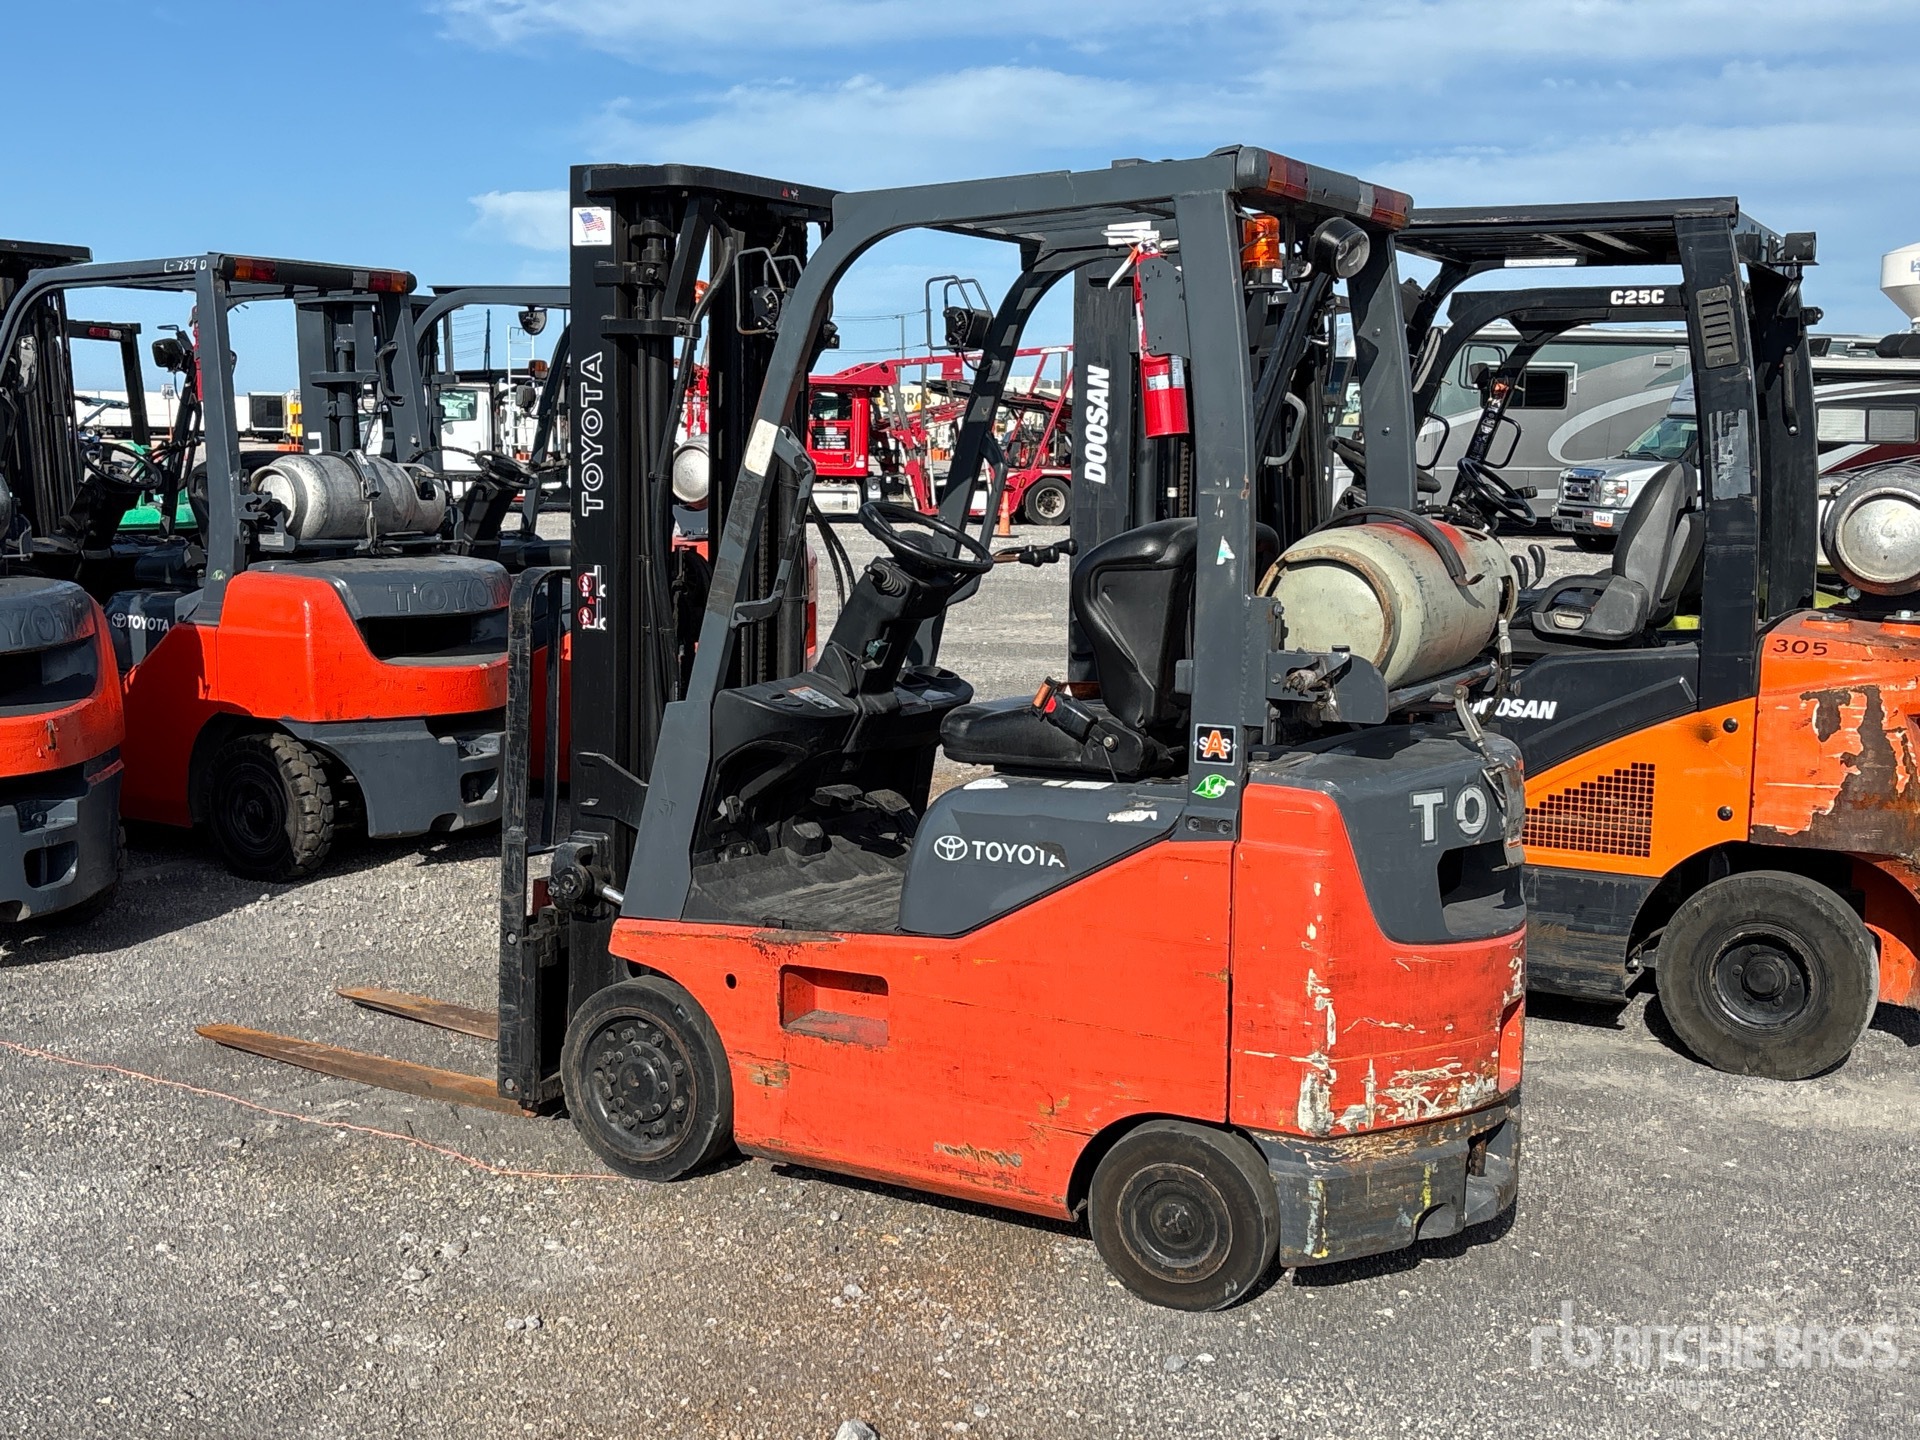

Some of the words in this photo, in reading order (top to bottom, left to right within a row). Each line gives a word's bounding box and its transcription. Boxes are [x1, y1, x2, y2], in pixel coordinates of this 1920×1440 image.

[1610, 289, 1664, 305] C25C
[581, 351, 604, 517] TOYOTA
[1084, 364, 1110, 485] DOOSAN
[127, 614, 170, 632] TOYOTA
[1772, 639, 1828, 655] 305
[971, 840, 1066, 868] TOYOTA
